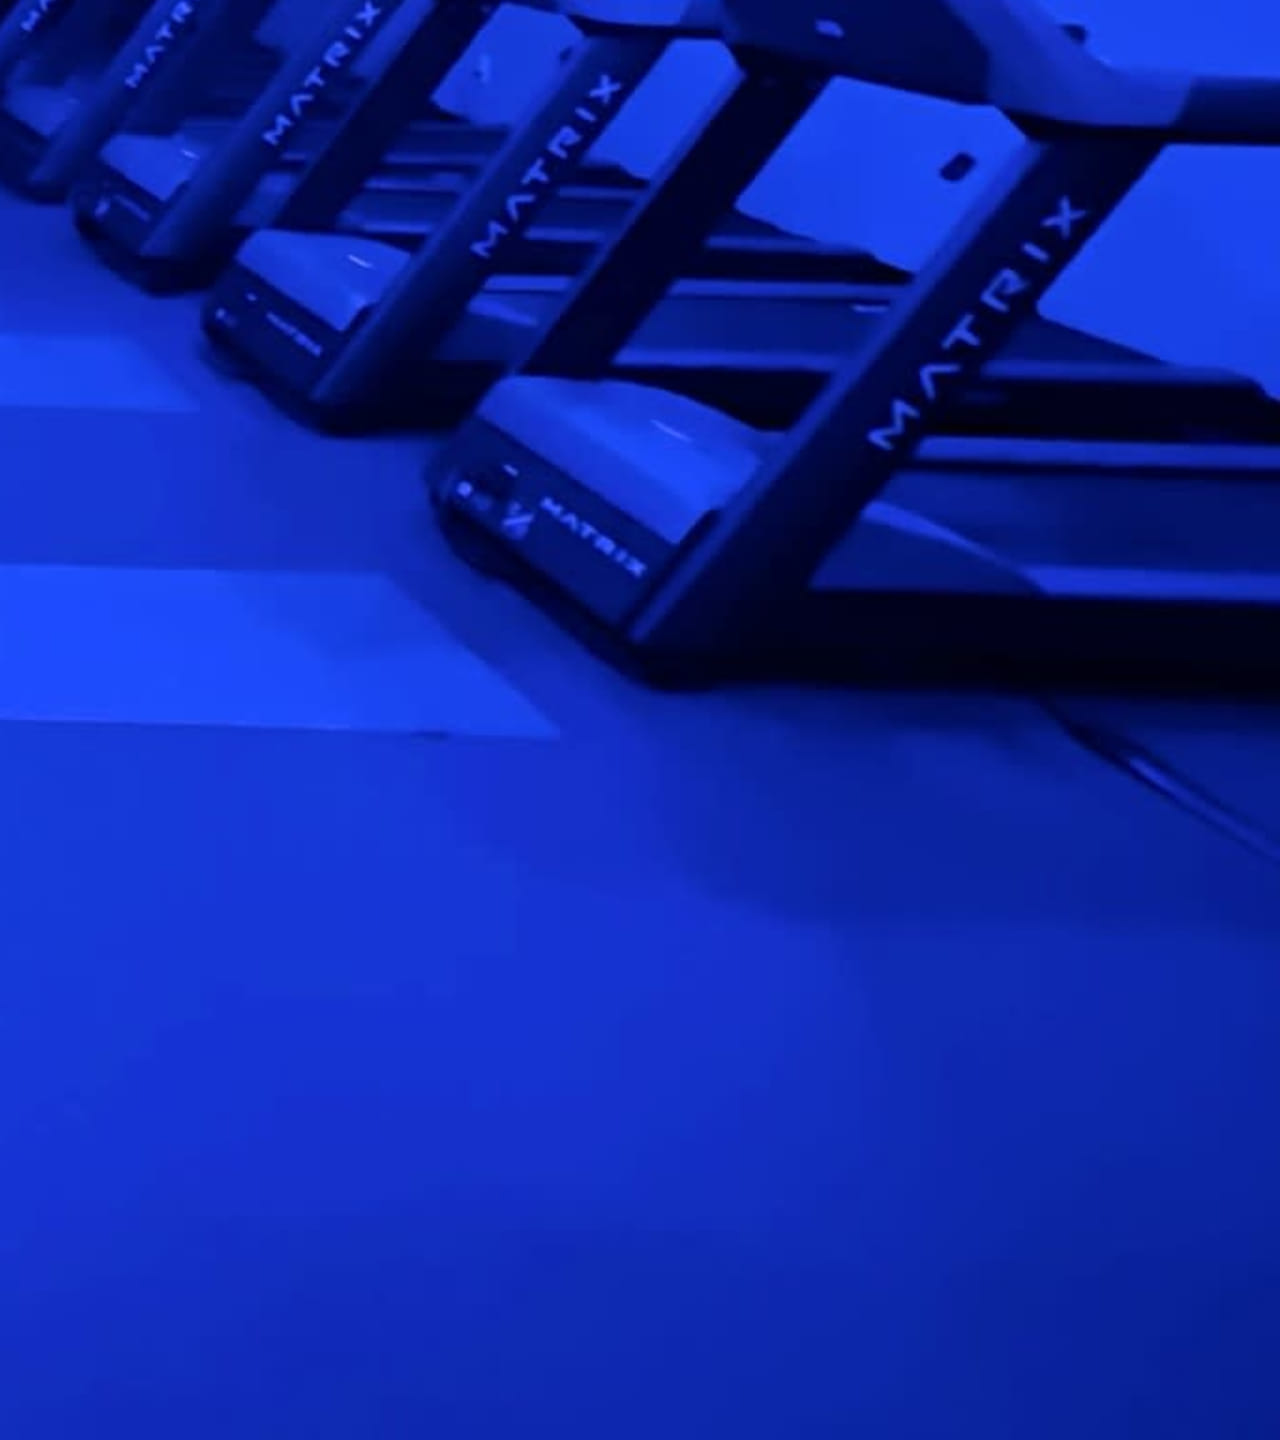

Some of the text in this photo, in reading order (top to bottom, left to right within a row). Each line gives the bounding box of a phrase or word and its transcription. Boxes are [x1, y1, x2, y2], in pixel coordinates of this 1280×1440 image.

[469, 75, 622, 259] MATRIX
[866, 194, 1087, 451] MATRIX
[540, 497, 647, 578] MATRIX
